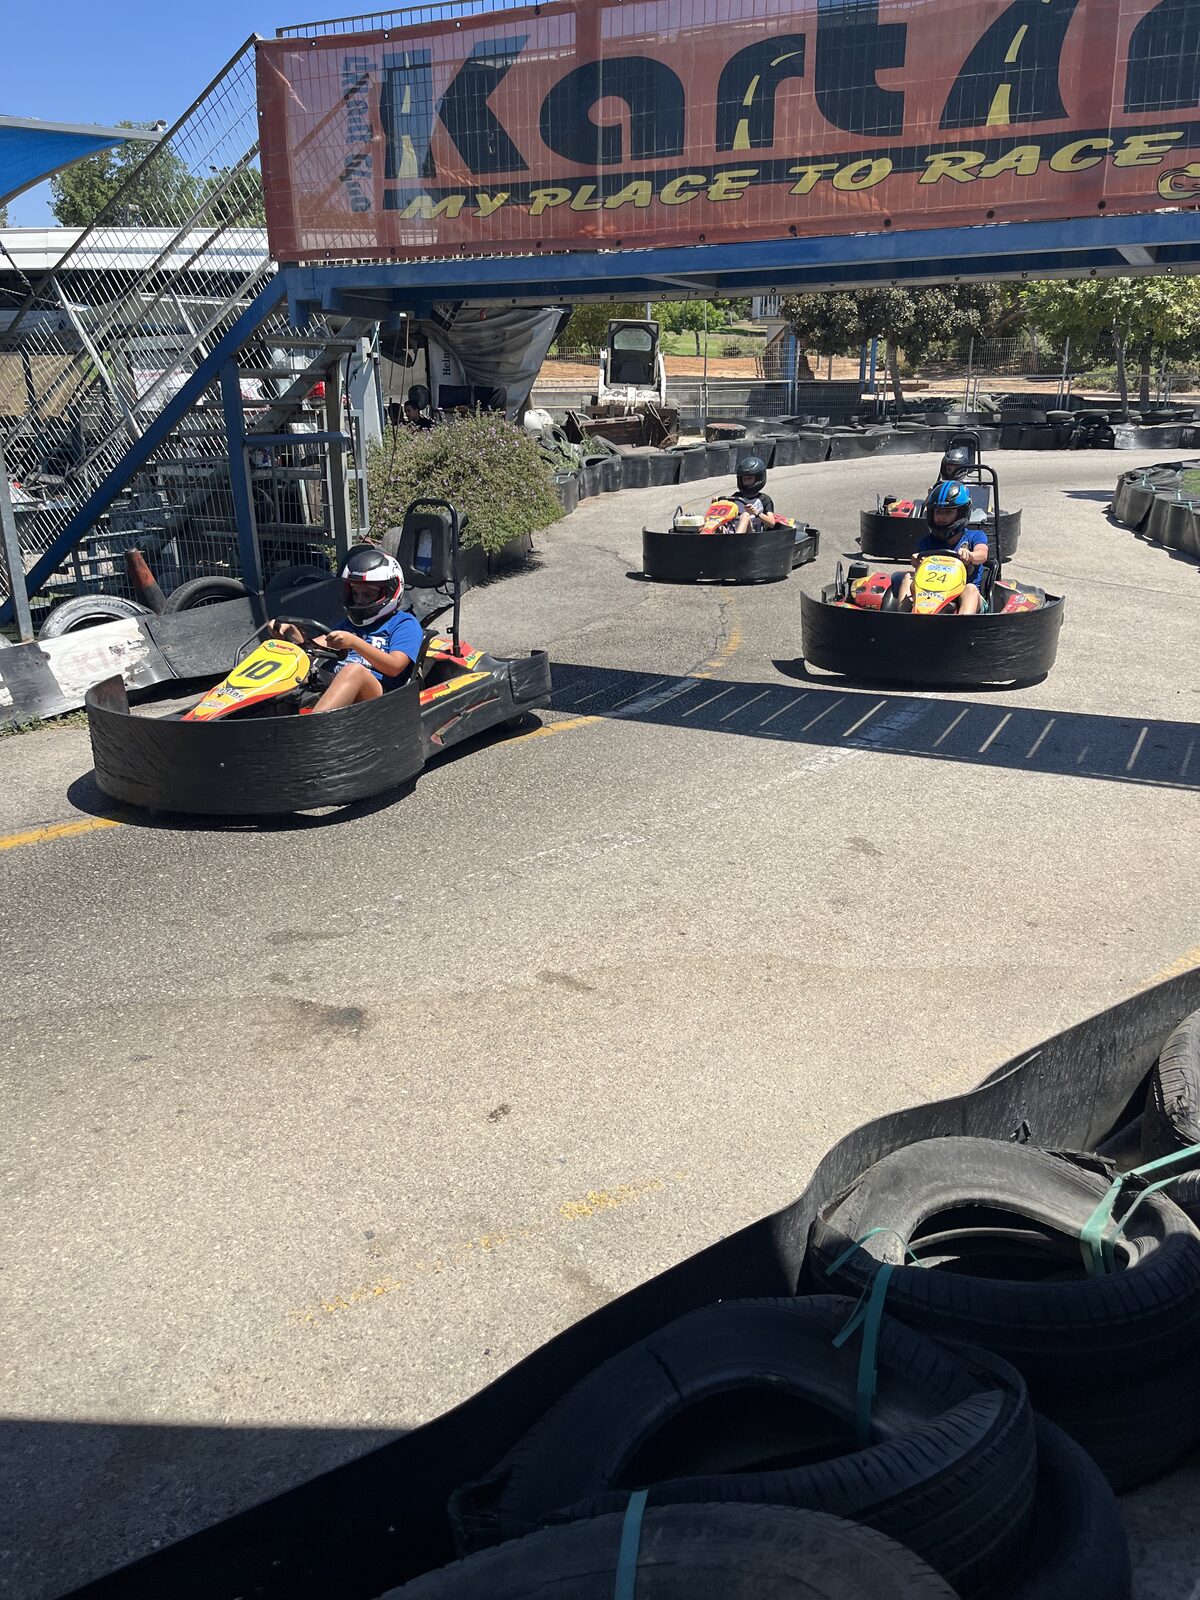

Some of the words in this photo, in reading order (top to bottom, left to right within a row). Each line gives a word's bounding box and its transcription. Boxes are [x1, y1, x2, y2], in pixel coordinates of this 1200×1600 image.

[400, 192, 511, 219] MY
[528, 168, 760, 217] PLACE
[788, 156, 893, 195] TO
[918, 132, 1185, 184] RACE
[711, 508, 728, 516] 20
[925, 571, 948, 583] 24
[236, 659, 282, 680] 10
